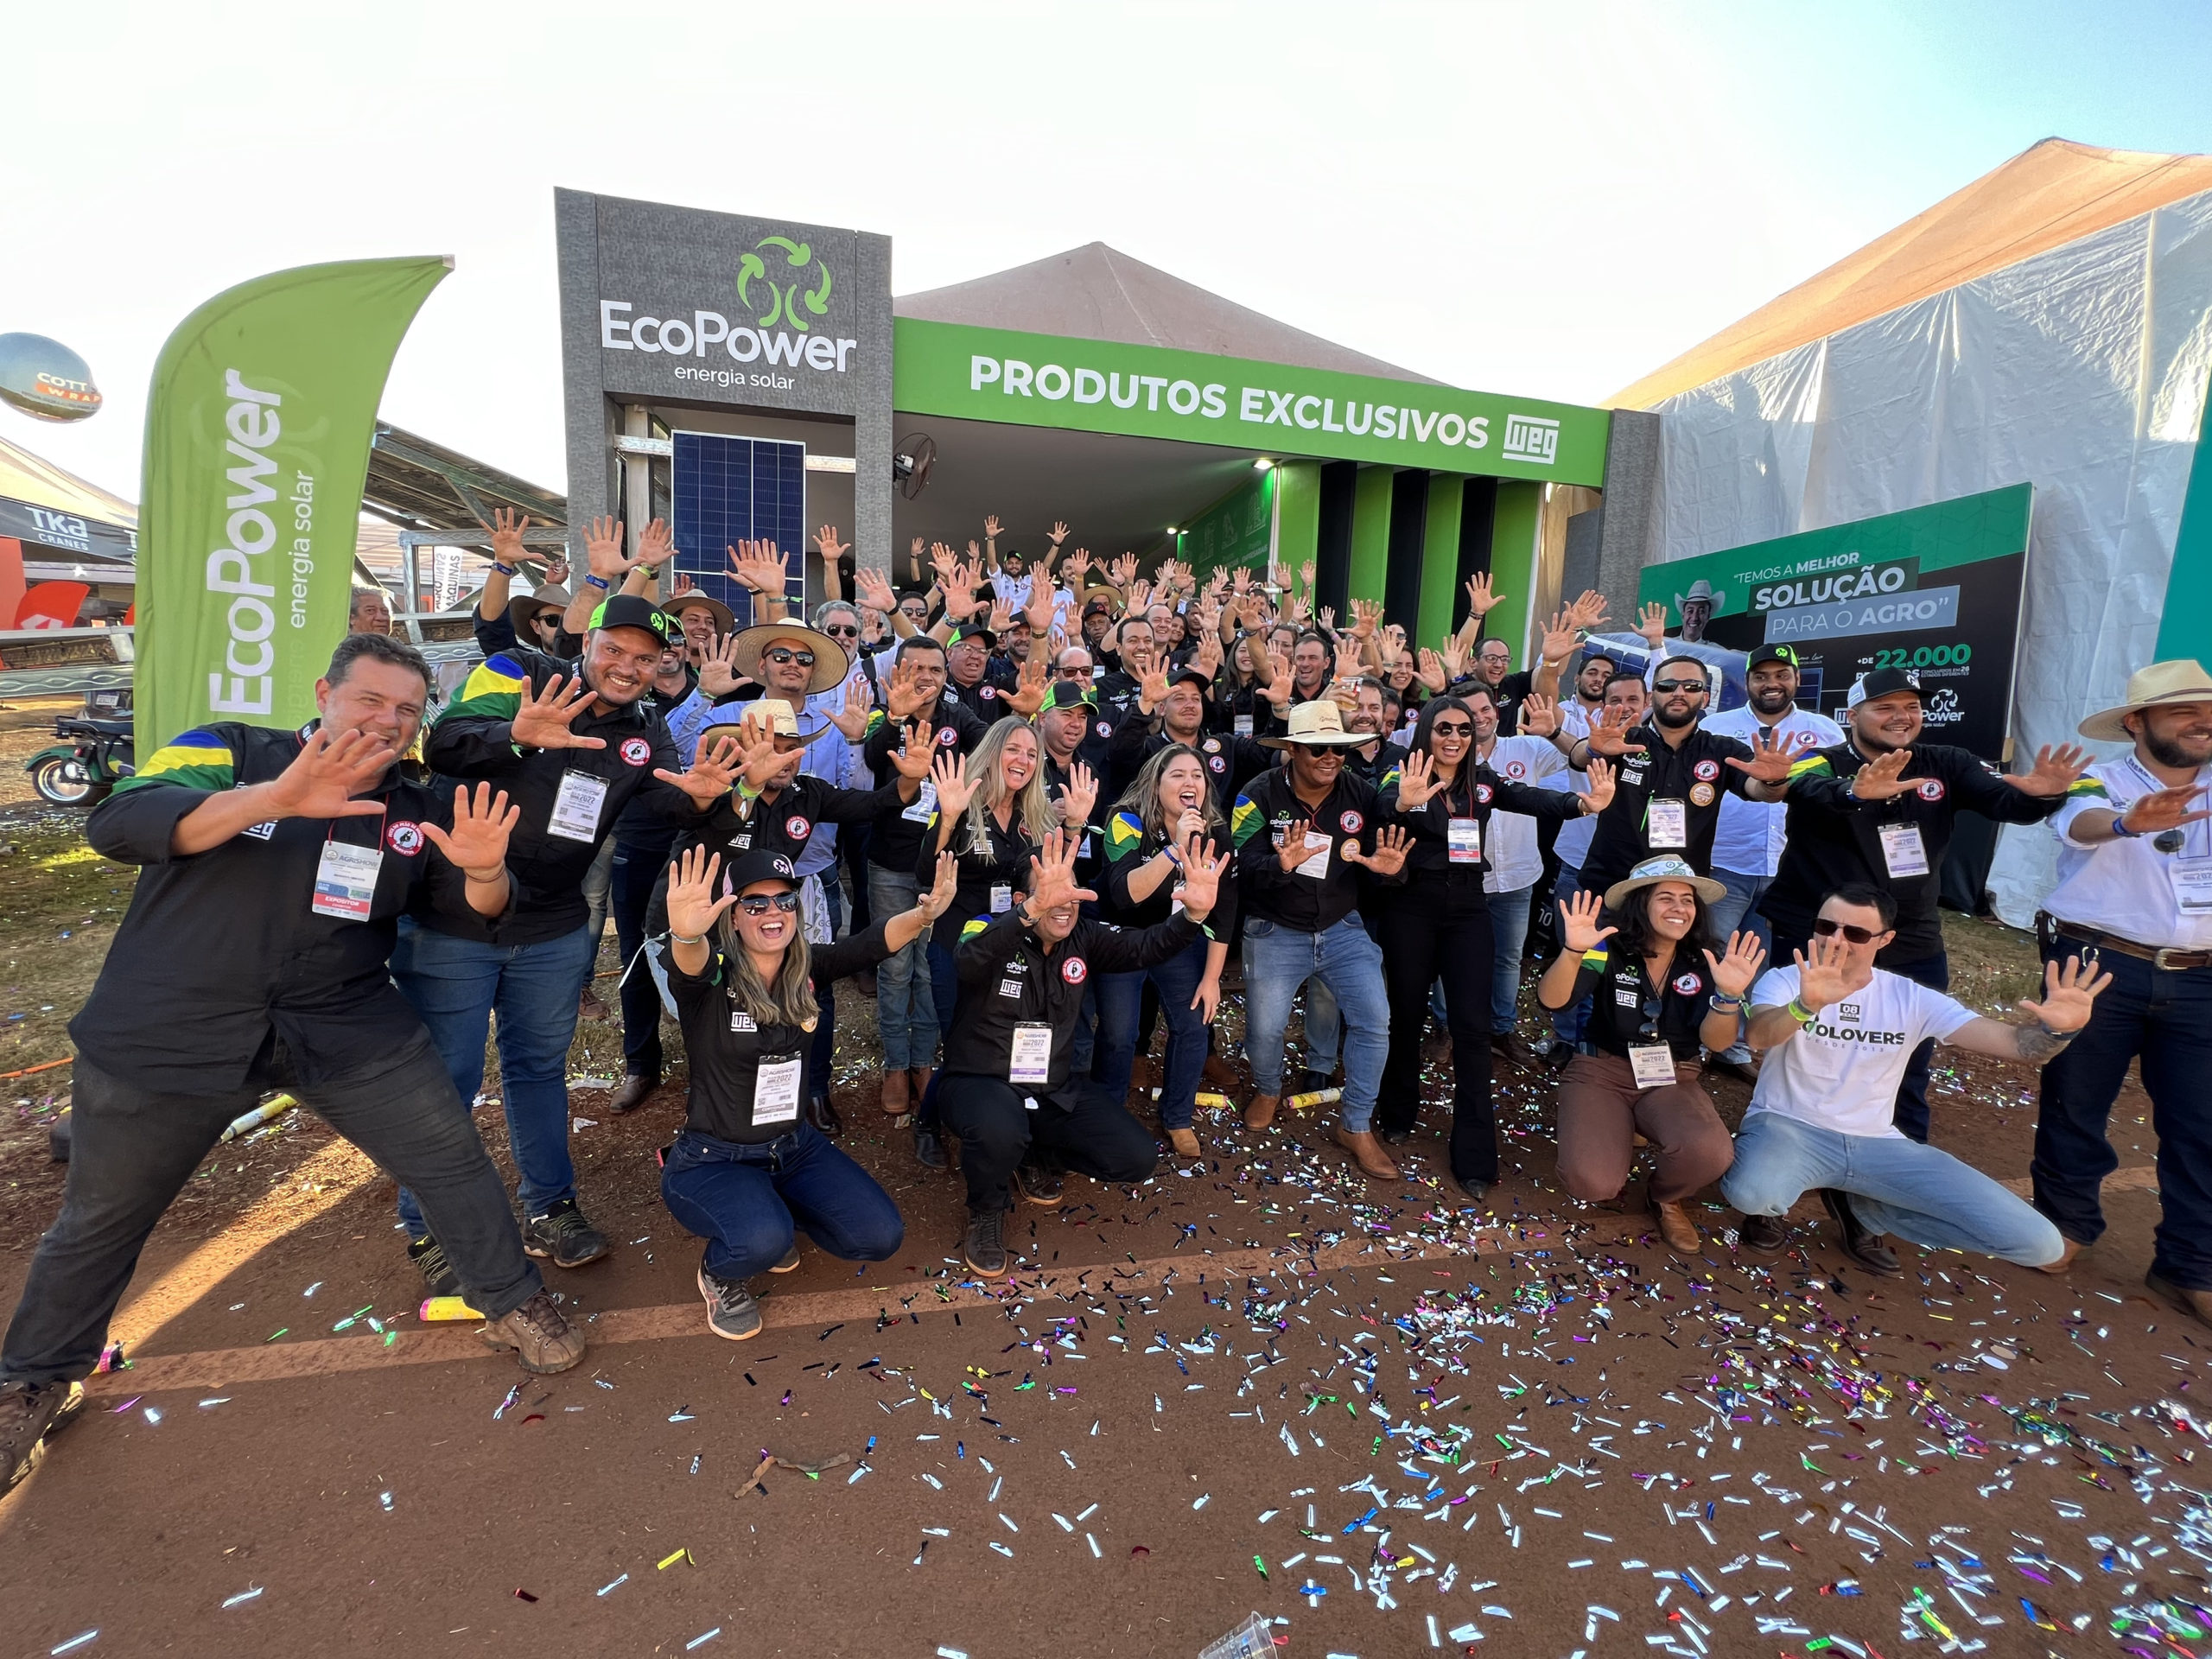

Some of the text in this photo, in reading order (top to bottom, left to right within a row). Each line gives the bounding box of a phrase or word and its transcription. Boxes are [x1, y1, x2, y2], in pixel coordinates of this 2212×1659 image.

[600, 299, 857, 372] EcoPower
[37, 372, 88, 391] COTT
[674, 366, 796, 390] energia solar
[970, 355, 1490, 449] PRODUTOS EXCLUSIVOS
[38, 532, 89, 551] CRANES
[206, 368, 282, 715] EcoPower
[289, 470, 315, 629] energia solar
[1783, 567, 1793, 575] A
[1796, 552, 1859, 575] MELHOR
[1755, 564, 1905, 611] SOLUÇÃO
[1772, 613, 1829, 635] PARA
[1834, 610, 1853, 628] O
[1875, 644, 1971, 671] 22.000
[1842, 1005, 1859, 1014] 08
[1805, 1035, 1846, 1049] DESDE
